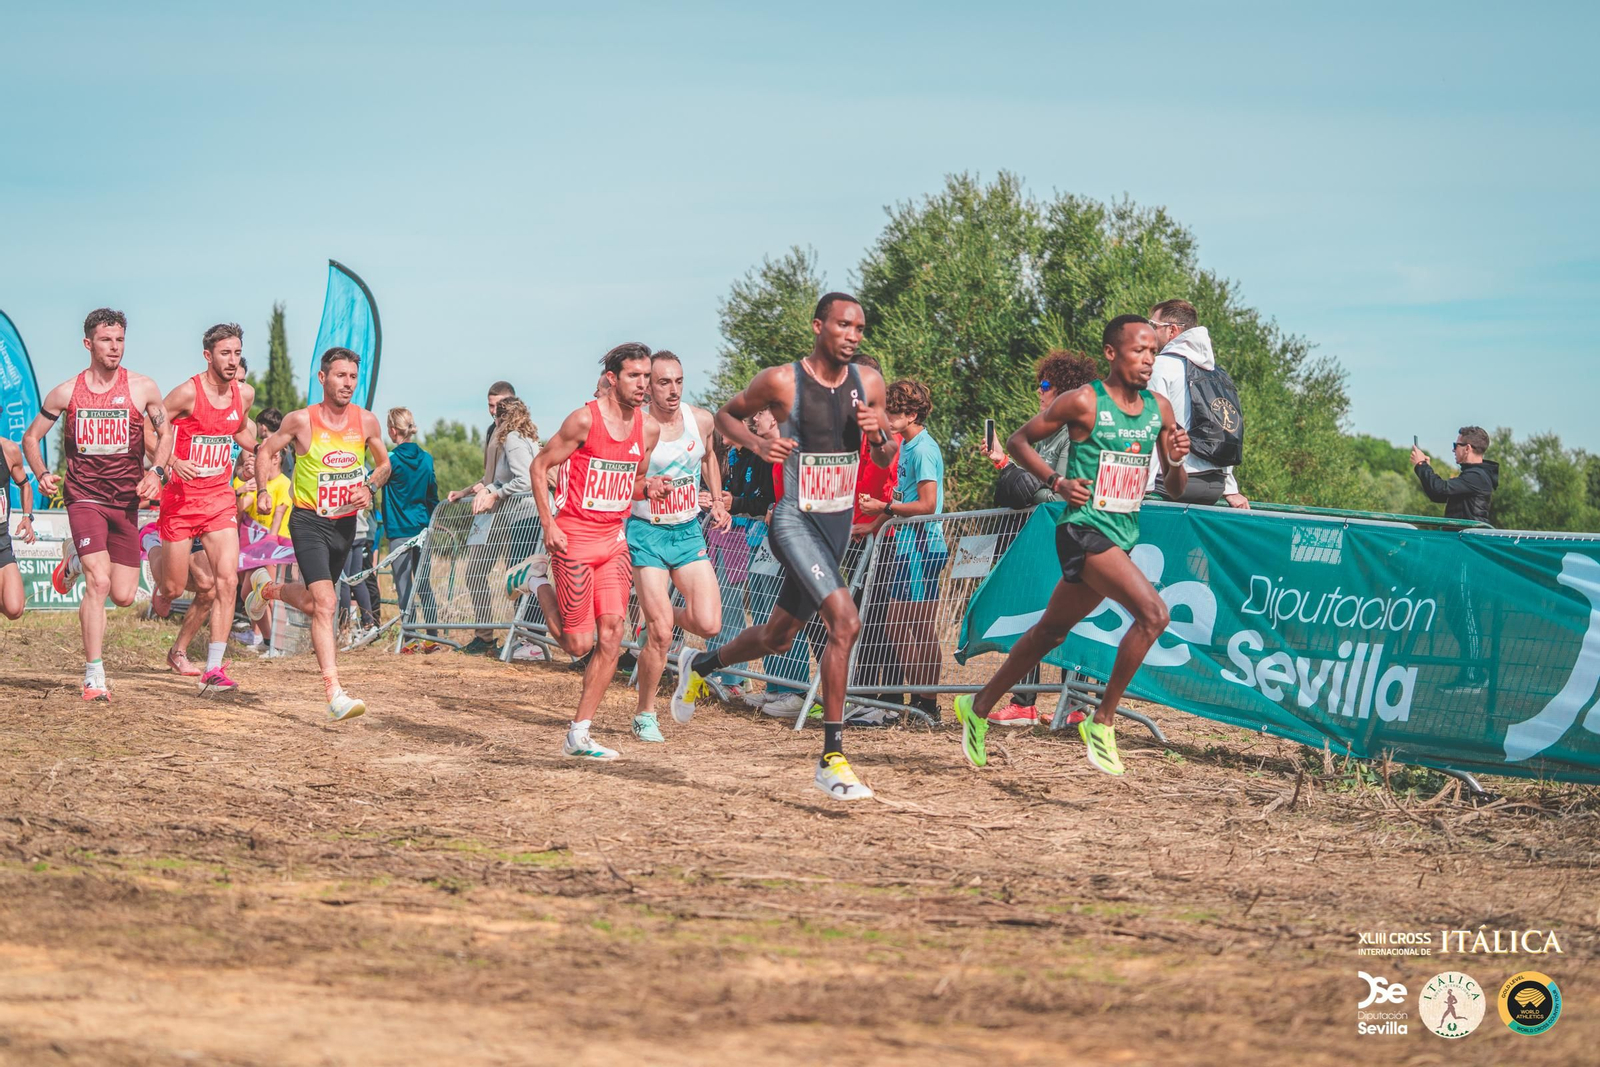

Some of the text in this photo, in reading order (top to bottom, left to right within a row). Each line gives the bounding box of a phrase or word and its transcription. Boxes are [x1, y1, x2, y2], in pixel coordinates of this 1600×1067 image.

[77, 418, 127, 445] LAS HERAS
[191, 444, 231, 468] MAIJO
[326, 455, 355, 465] Serrano
[318, 481, 363, 508] PÉR
[586, 469, 634, 501] RAMOS
[650, 483, 696, 515] MENACHO
[14, 547, 55, 557] nternational
[1241, 575, 1436, 632] Diputación
[1220, 630, 1419, 722] Sevilla
